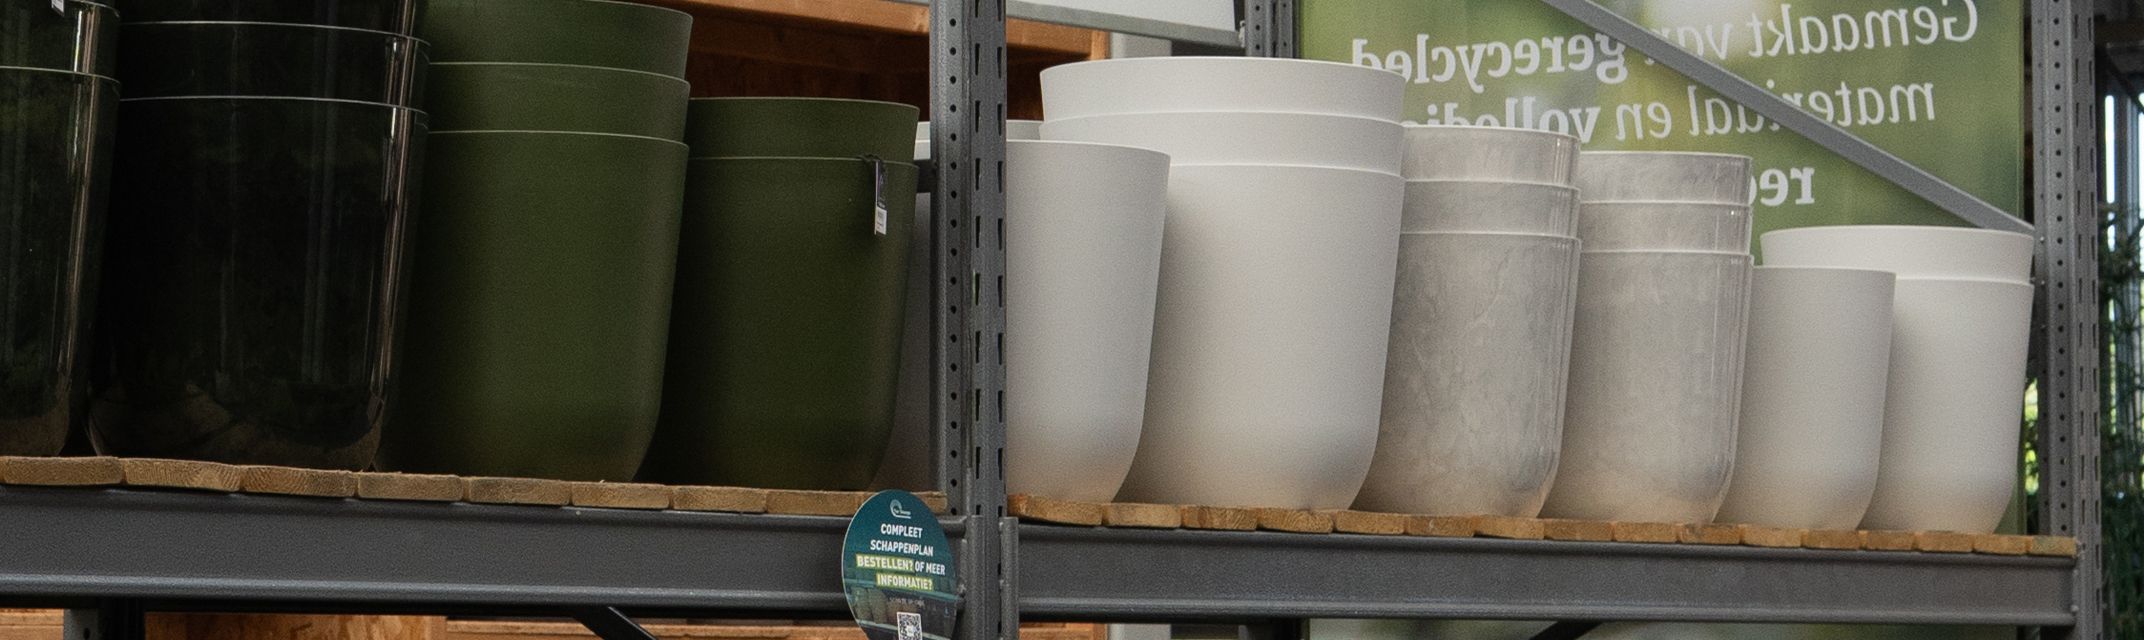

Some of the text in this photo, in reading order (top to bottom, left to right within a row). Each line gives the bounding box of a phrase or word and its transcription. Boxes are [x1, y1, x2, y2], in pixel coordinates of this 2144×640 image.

[880, 523, 923, 538] COMPLEET
[870, 540, 933, 557] SCHAPPENPLAN
[857, 556, 945, 575] BESTELLEN? OF MEER
[877, 574, 932, 590] INFORMATIE?
